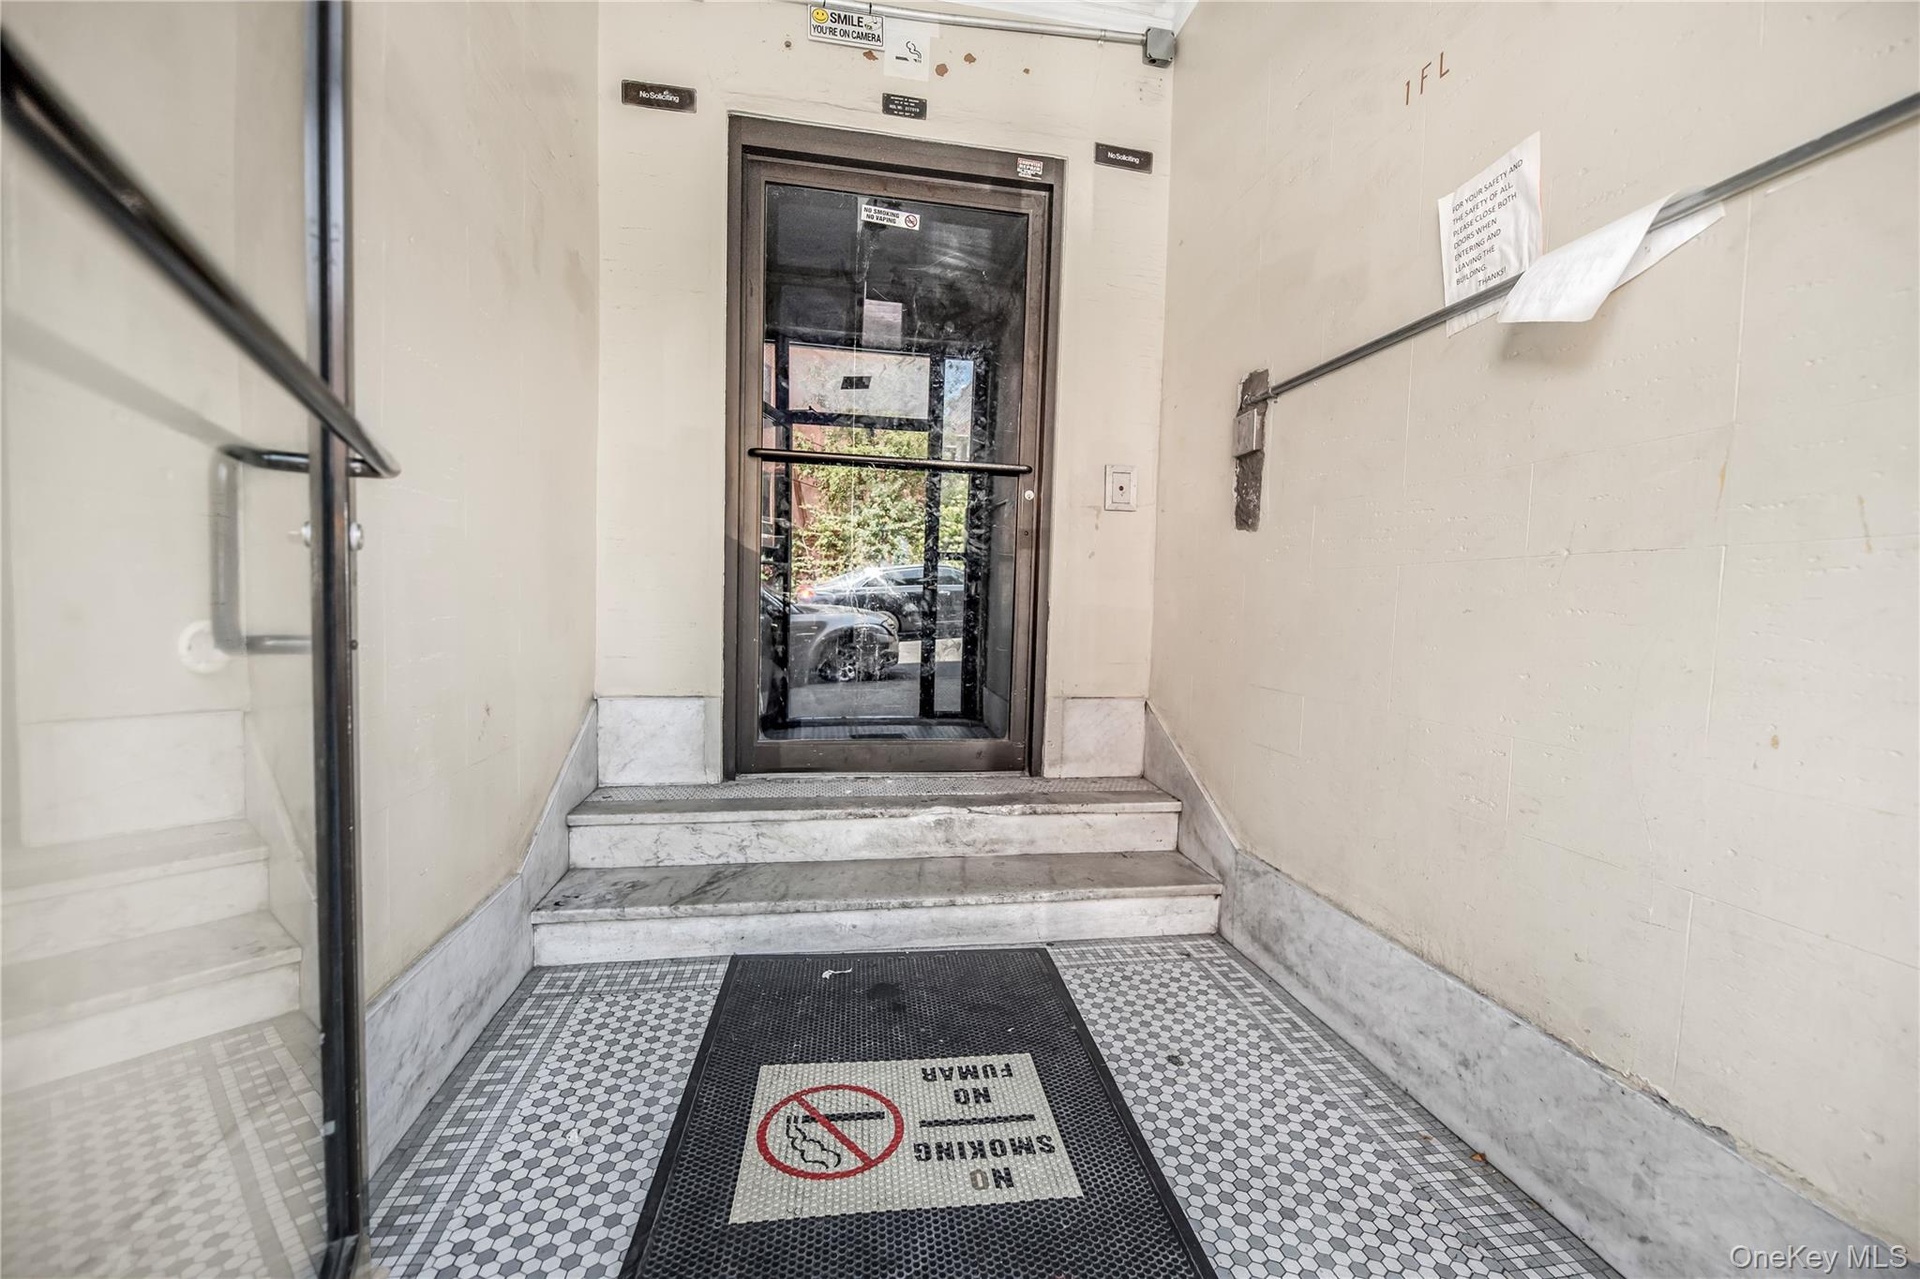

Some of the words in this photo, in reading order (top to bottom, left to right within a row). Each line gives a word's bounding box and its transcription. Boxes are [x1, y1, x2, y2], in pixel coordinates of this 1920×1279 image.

[830, 12, 864, 28] SMILE
[812, 24, 838, 37] YOU'RE
[839, 28, 850, 38] ON
[851, 30, 882, 43] CAMERA
[639, 90, 649, 98] No
[1108, 151, 1116, 159] No
[1116, 153, 1140, 164] Soliciting
[1452, 201, 1464, 214] FOR
[1465, 188, 1483, 204] YOUR
[1484, 171, 1508, 192] SAFETY
[1508, 159, 1523, 174] AND
[873, 208, 900, 219] SMOKING
[1453, 213, 1464, 225] THE
[1465, 197, 1488, 218] SAFETY
[1489, 190, 1498, 201] OF
[1453, 219, 1474, 237] PLEASE
[1474, 205, 1496, 222] CLOSE
[1497, 192, 1517, 209] BOTH
[875, 215, 897, 224] VAPING
[1453, 231, 1475, 250] DOORS
[1475, 217, 1497, 235] WHEN
[1454, 238, 1486, 262] ENTERING
[1486, 228, 1501, 241] AND
[1455, 253, 1482, 274] LEAVING
[1483, 244, 1495, 257] THE
[1478, 266, 1507, 286] THANKS!
[921, 1063, 1013, 1082] FUMAR
[953, 1087, 991, 1105] NO
[914, 1134, 1056, 1162] SMOKING
[969, 1167, 1014, 1191] NO
